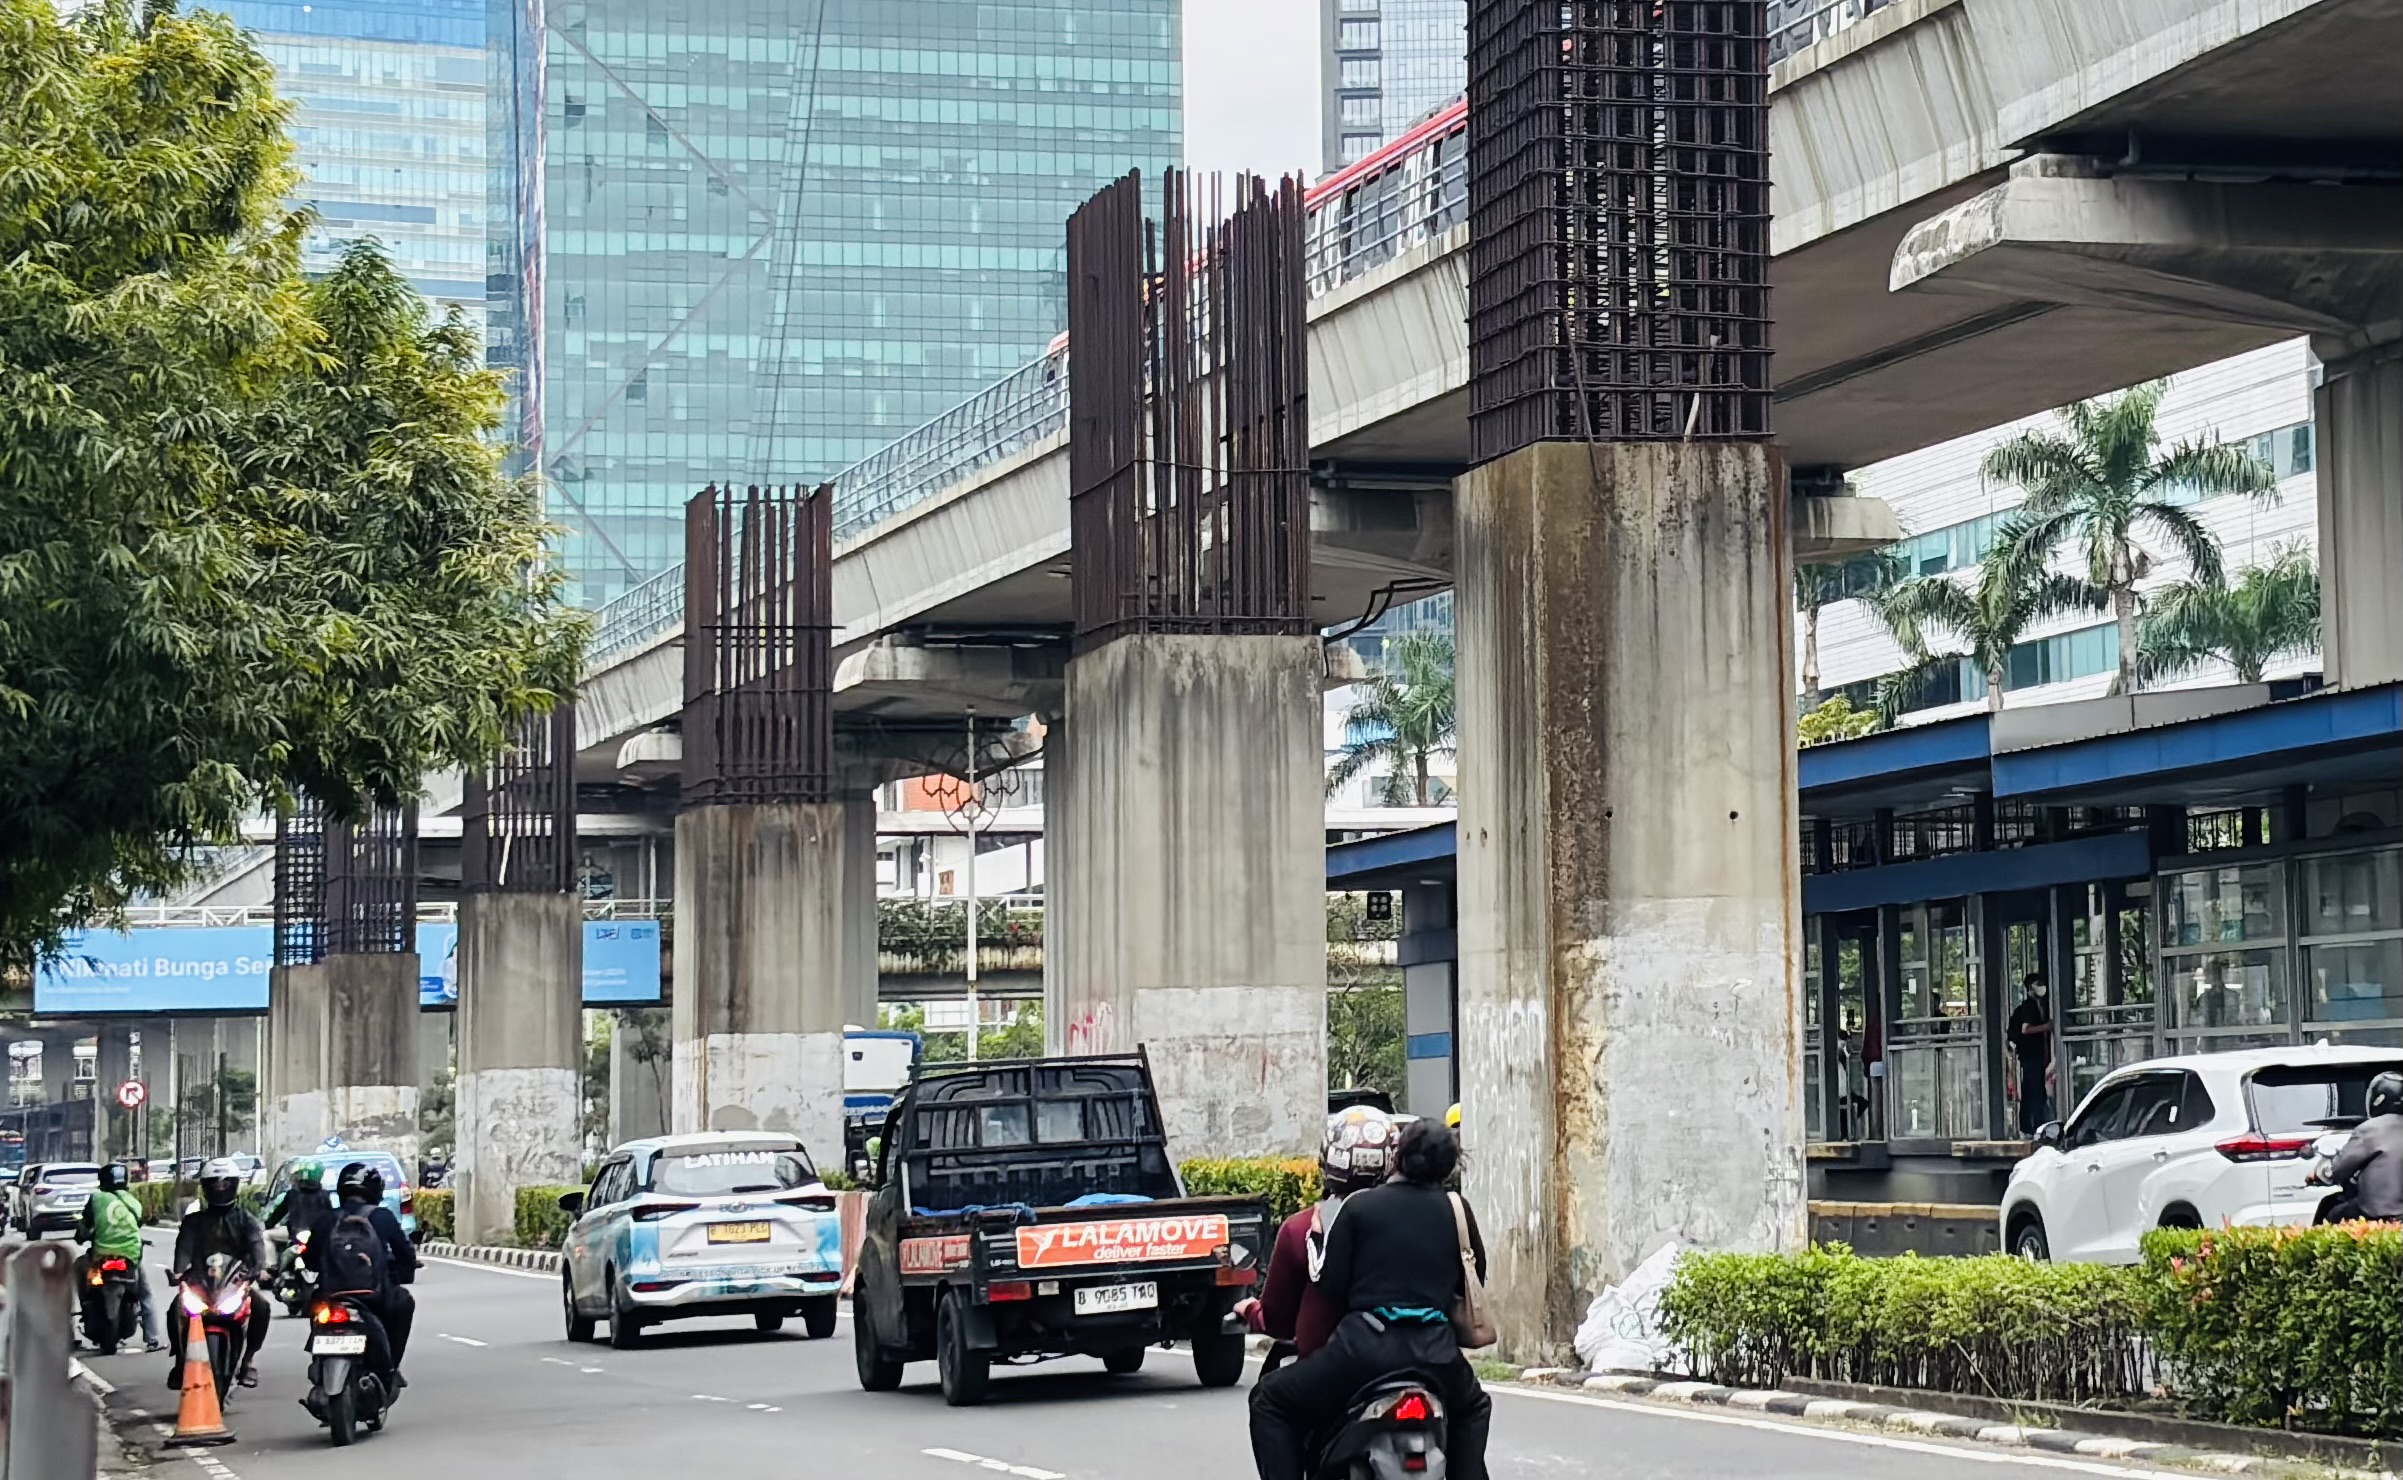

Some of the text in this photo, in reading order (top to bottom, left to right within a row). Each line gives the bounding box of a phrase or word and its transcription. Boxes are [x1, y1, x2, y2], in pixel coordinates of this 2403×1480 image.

[154, 957, 229, 981] Bunga
[684, 1151, 776, 1169] LATIHAN
[1062, 1219, 1218, 1248] LALAMOVE
[1093, 1241, 1187, 1260] deliver faster
[1078, 1291, 1087, 1306] B
